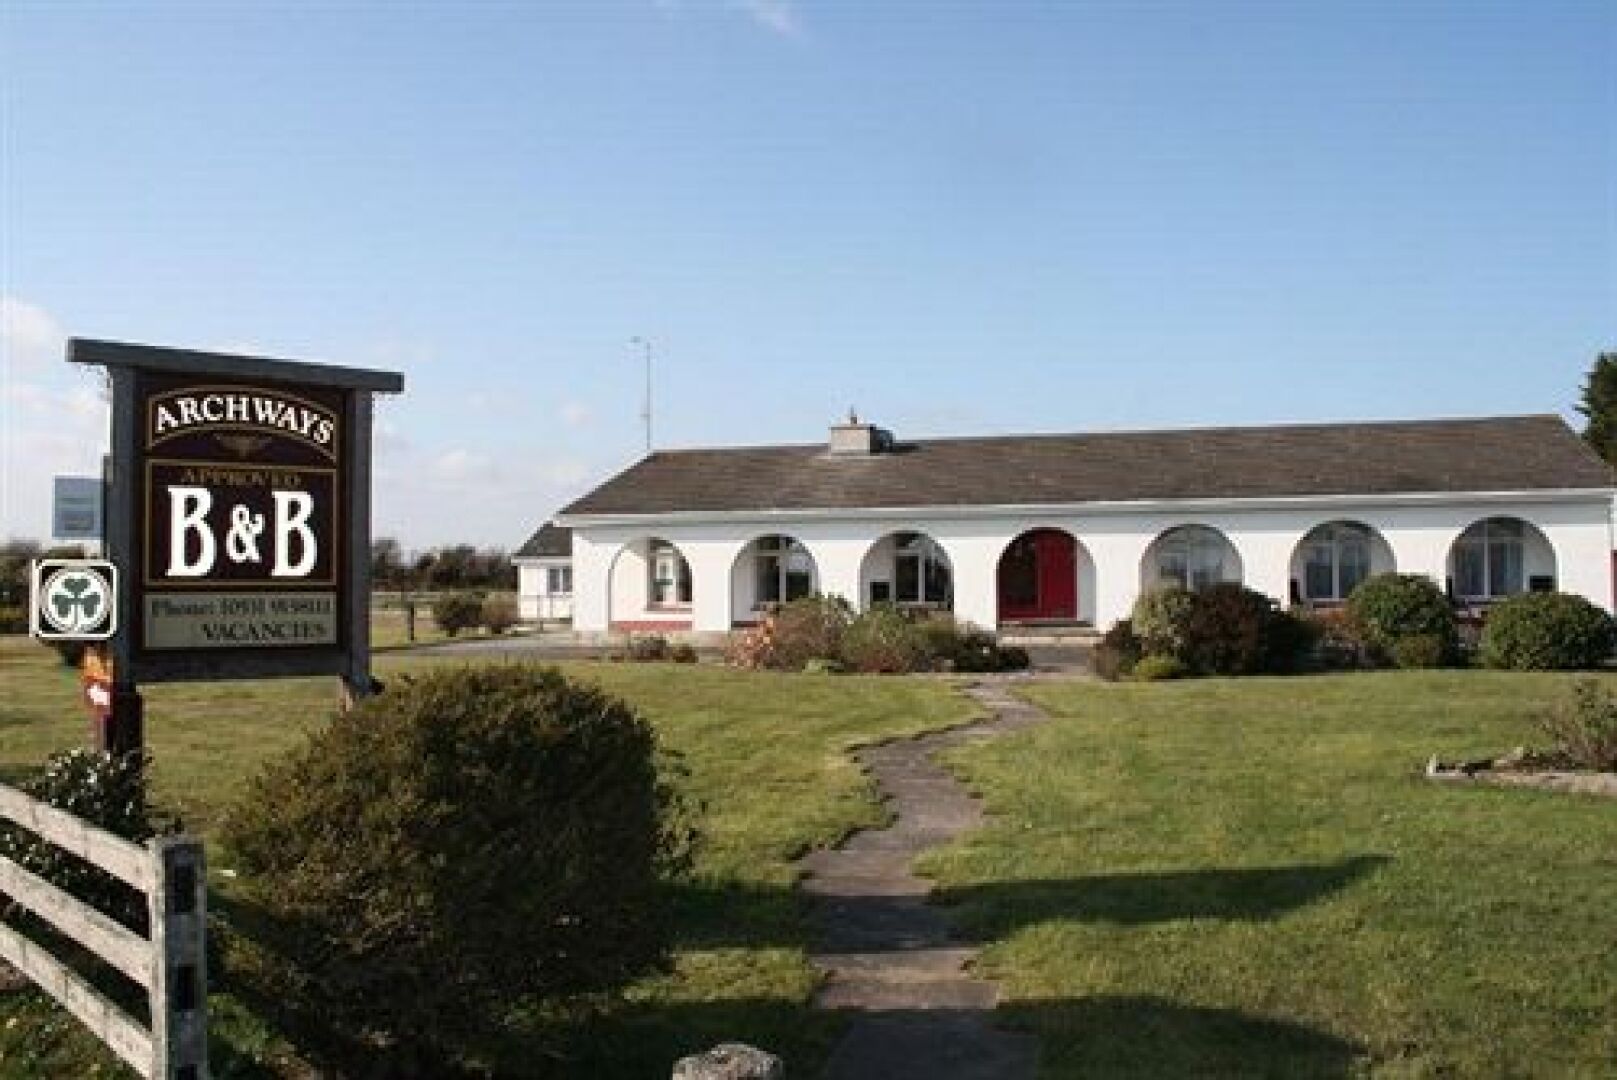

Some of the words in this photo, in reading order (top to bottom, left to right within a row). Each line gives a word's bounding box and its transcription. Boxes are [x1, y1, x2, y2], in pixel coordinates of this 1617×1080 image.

[155, 395, 333, 443] ARCHWAYS
[165, 486, 217, 576] B
[226, 504, 265, 563] &
[271, 490, 317, 576] B
[201, 622, 328, 640] VACANCIES
